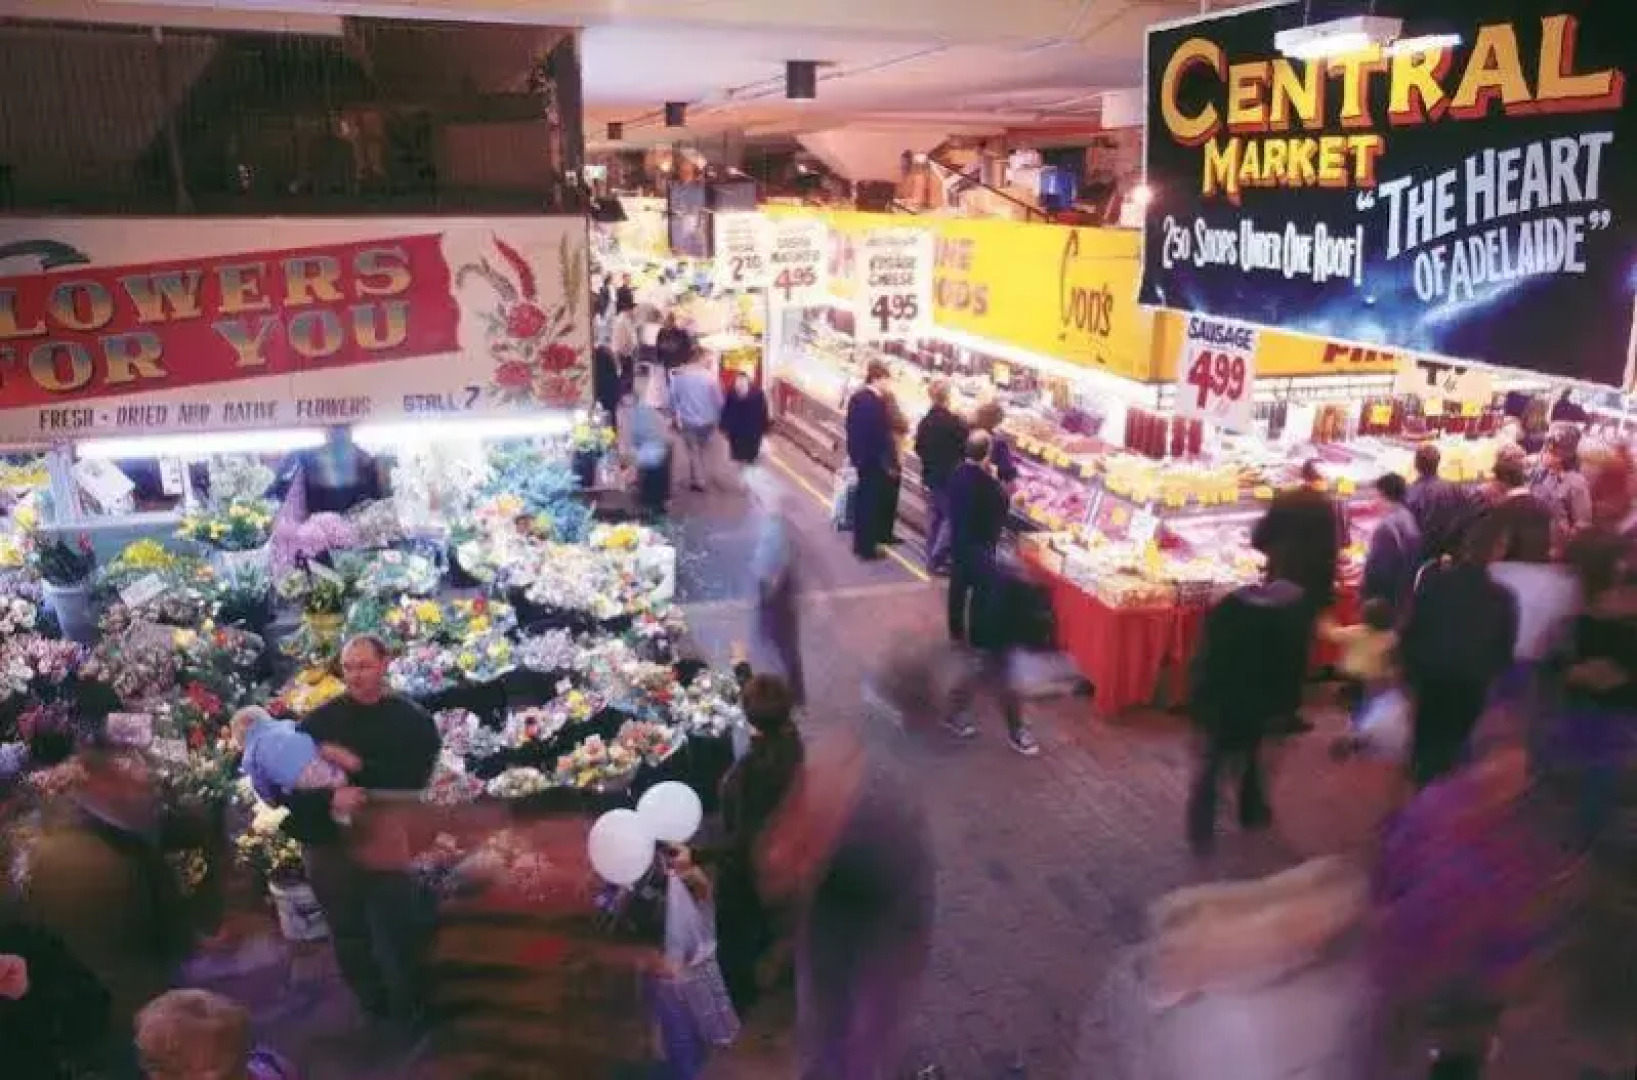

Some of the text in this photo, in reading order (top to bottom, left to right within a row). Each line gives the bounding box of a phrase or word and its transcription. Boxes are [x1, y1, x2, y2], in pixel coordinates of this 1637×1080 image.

[1161, 15, 1625, 145] CENTRAL
[1203, 134, 1385, 207] MARKET
[1464, 131, 1614, 227] HEART
[1162, 214, 1192, 269] 250
[1413, 244, 1447, 301] OF
[211, 301, 410, 369] YOU
[1188, 317, 1253, 351] SAUSAGE
[39, 395, 371, 430] FRESH DRIED AND NATIVE FLOWERS
[403, 385, 481, 413] STALL 7
